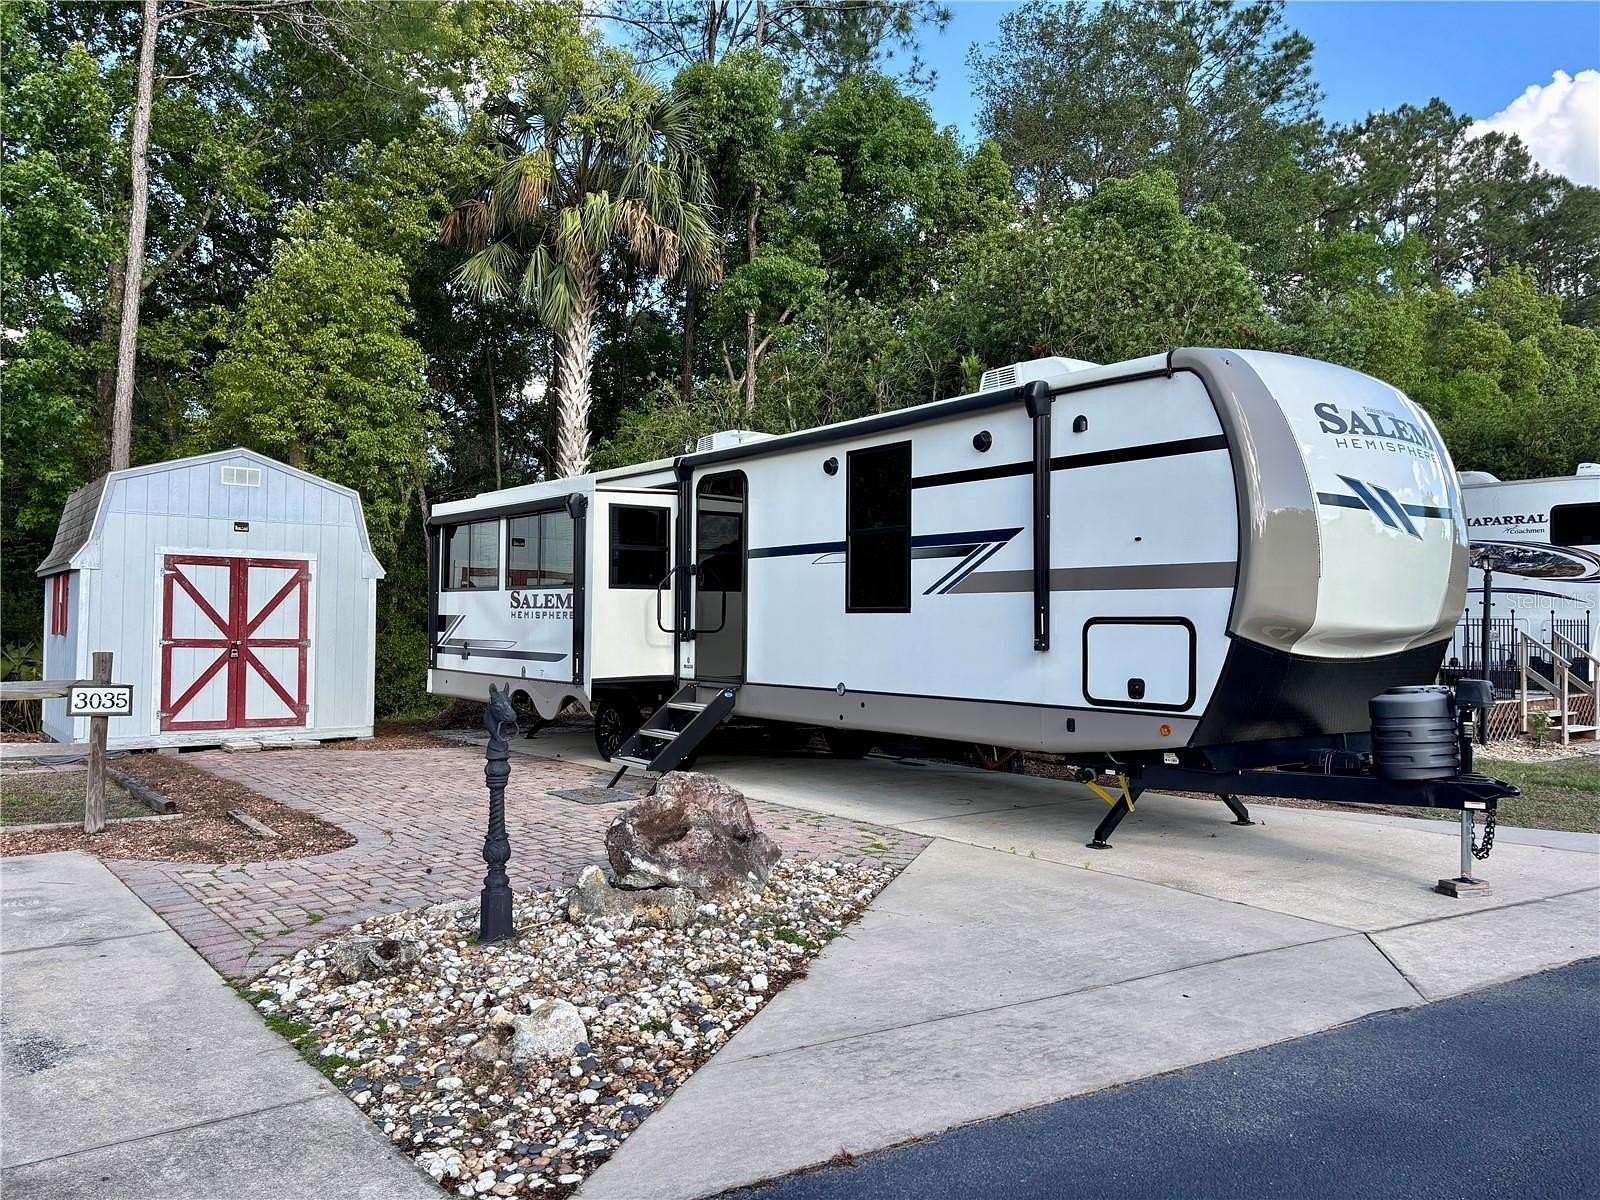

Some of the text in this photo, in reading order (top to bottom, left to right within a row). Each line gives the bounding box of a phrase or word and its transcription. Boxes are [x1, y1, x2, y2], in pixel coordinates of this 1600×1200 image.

[1314, 402, 1434, 451] SALEM
[1335, 437, 1437, 463] HEMISPHERE
[510, 591, 574, 609] SALEM
[511, 611, 574, 619] HEMISPHERE
[74, 692, 128, 710] 3035
